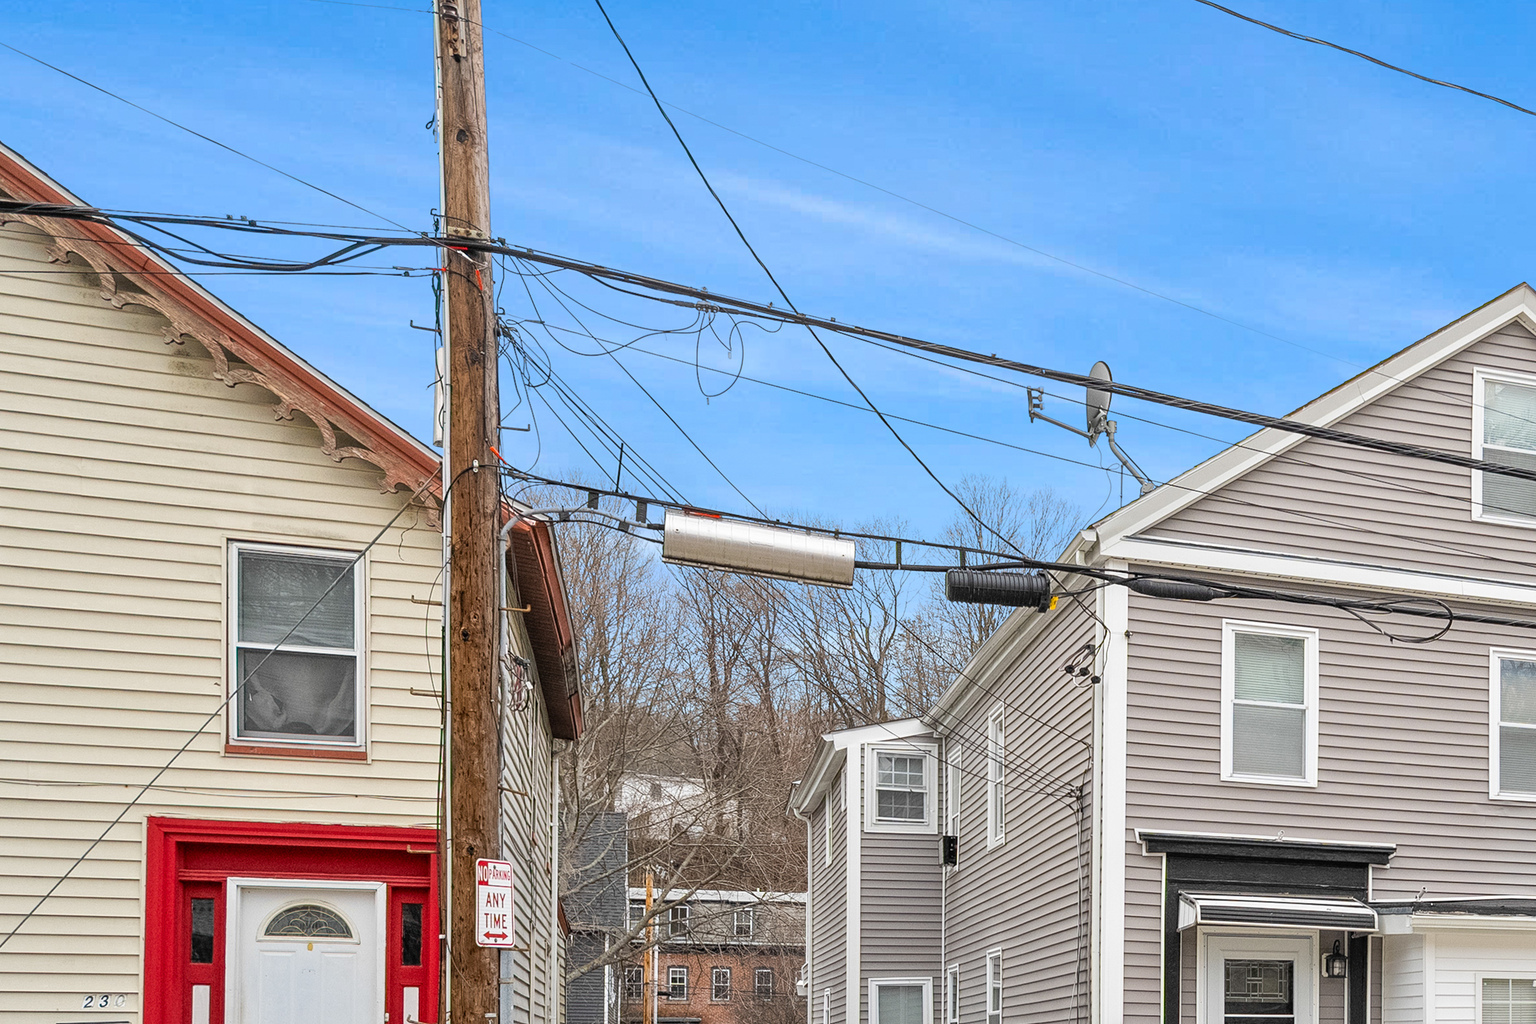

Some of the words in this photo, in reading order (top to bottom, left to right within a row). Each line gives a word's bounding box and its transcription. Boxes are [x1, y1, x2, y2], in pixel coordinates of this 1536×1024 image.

[478, 865, 488, 882] NO
[489, 868, 511, 881] PARKING
[485, 892, 506, 908] ANY
[484, 913, 508, 929] TIME
